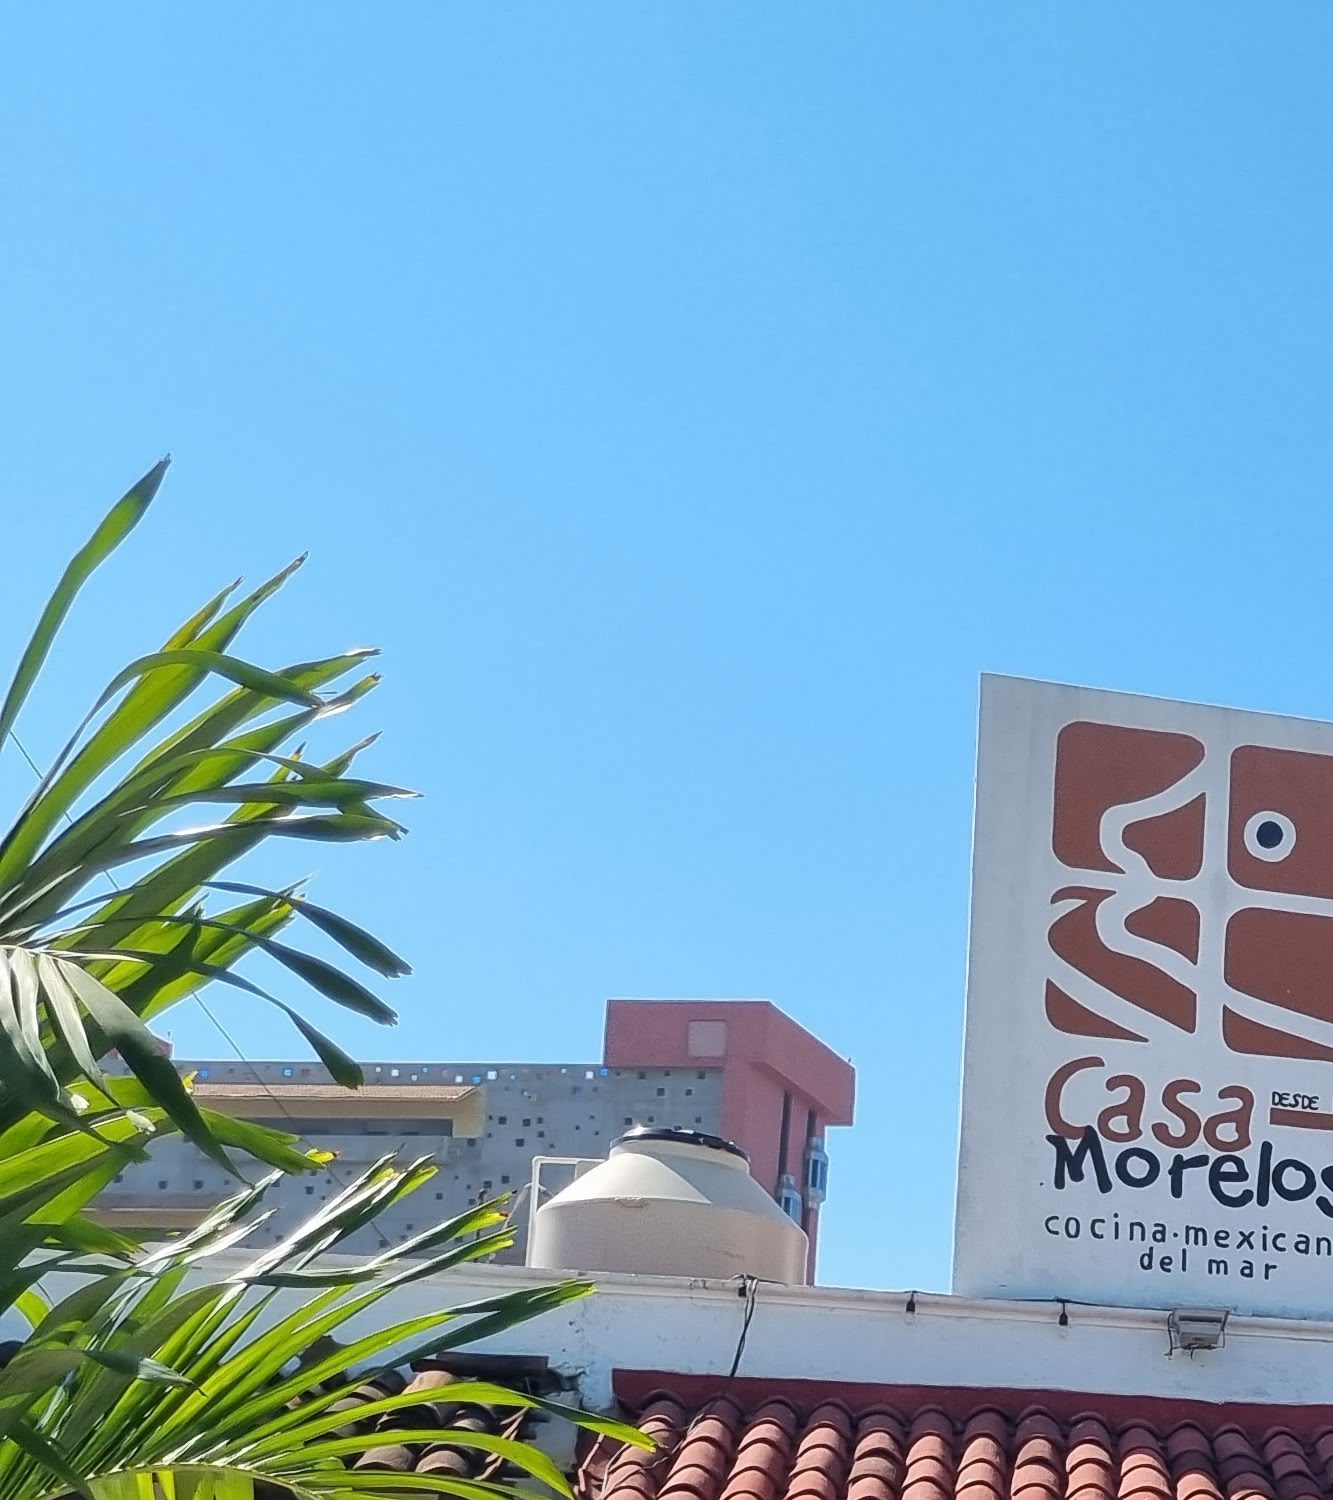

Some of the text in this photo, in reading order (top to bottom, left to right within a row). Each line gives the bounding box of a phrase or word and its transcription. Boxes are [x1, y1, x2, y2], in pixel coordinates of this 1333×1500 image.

[1045, 1056, 1254, 1152] Casa
[1272, 1091, 1319, 1111] DESDE
[1140, 1246, 1277, 1280] del mar
